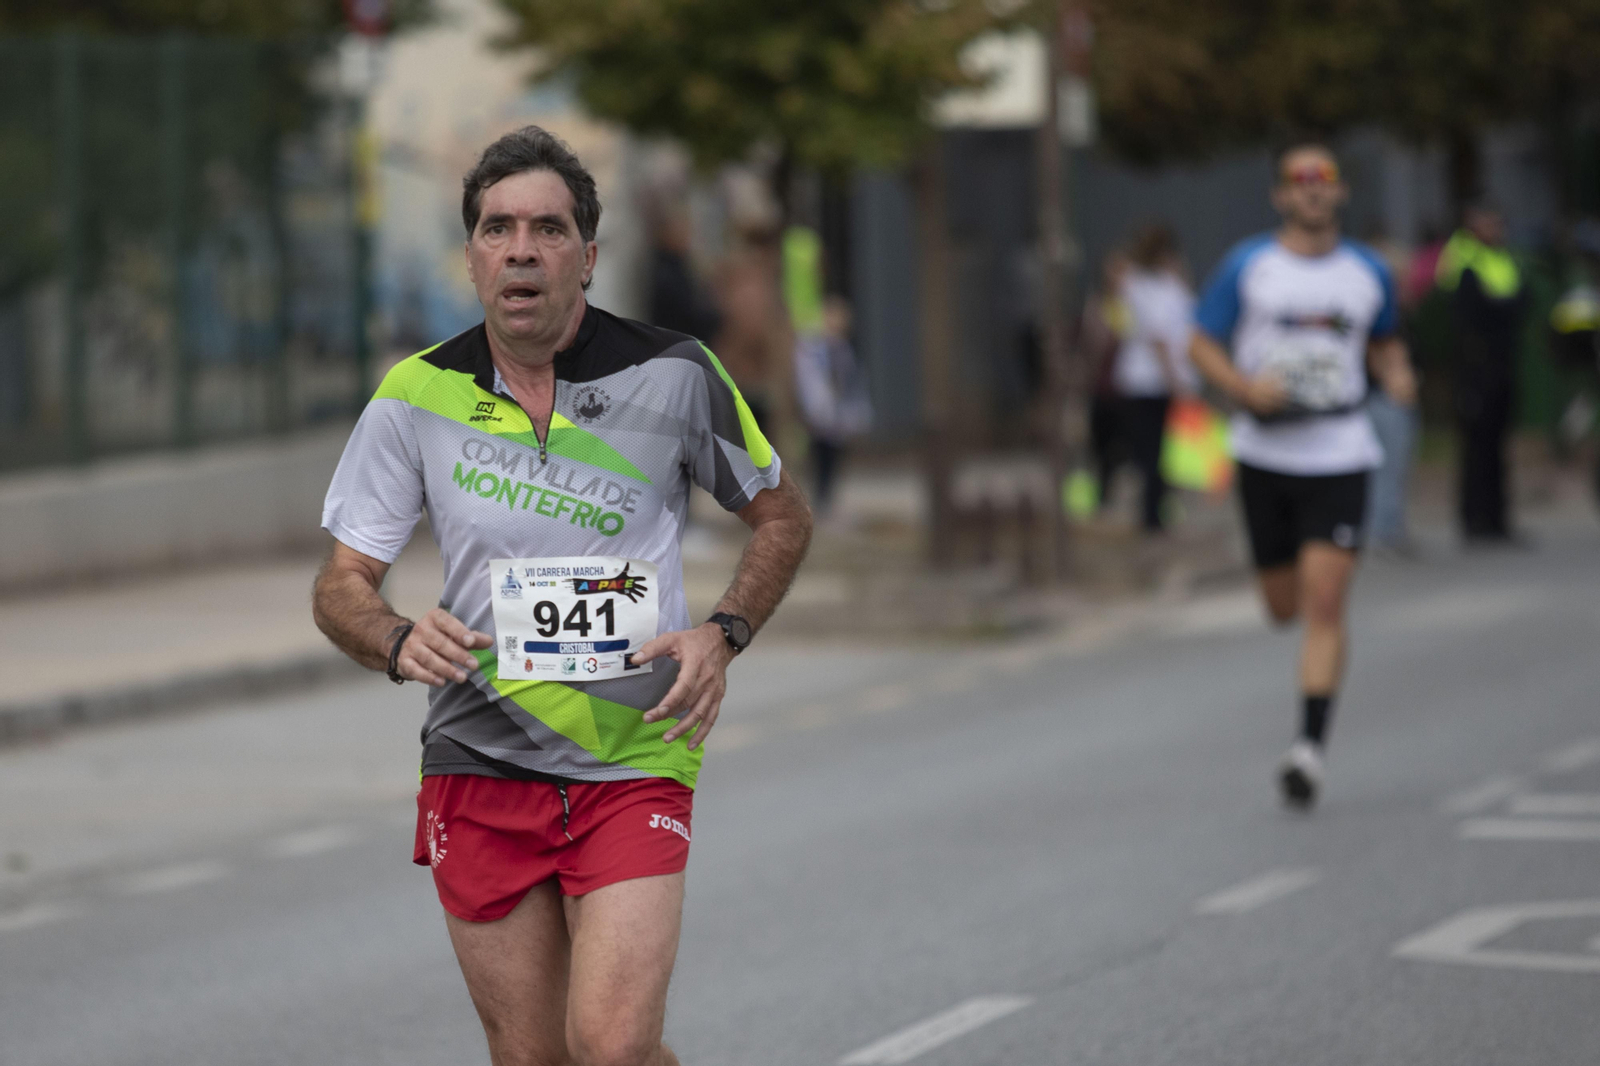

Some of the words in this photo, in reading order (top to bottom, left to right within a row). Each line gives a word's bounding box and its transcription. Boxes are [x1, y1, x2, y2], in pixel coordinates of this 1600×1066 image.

[452, 461, 625, 537] MONTEFRIO
[525, 568, 535, 577] VII
[537, 567, 571, 577] CARRERA
[573, 566, 605, 577] MARCHA
[578, 579, 634, 591] ASPACE
[533, 598, 614, 638] 941
[559, 643, 596, 653] CRISTOBAL
